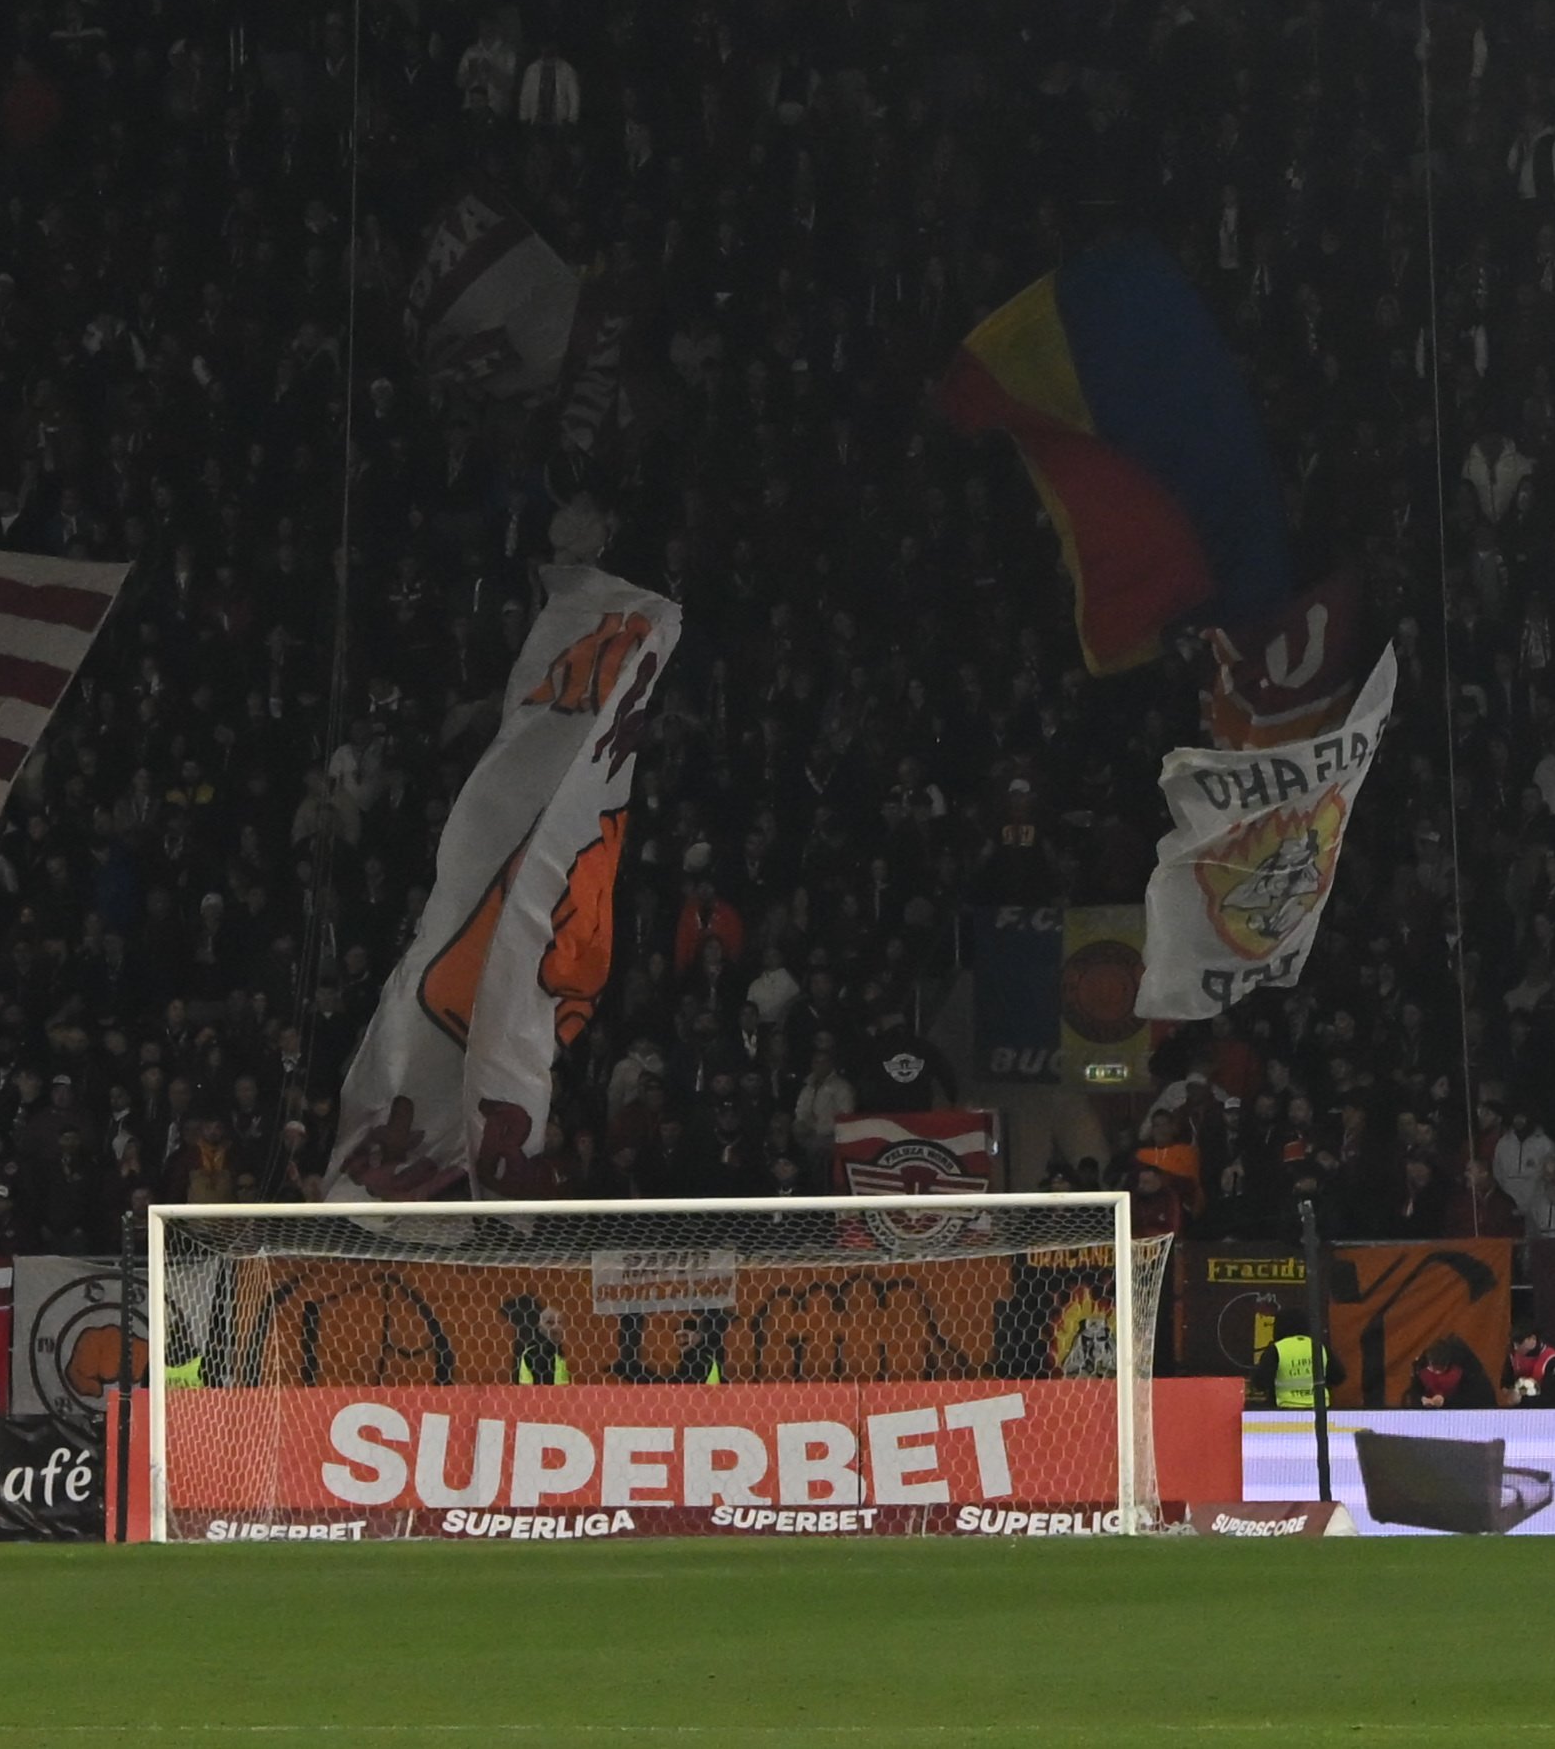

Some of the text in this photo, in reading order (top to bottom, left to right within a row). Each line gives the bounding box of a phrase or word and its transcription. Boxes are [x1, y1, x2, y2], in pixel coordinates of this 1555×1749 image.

[321, 1392, 1026, 1509] SUPERBET
[206, 1519, 368, 1542] SUPERBET
[441, 1508, 635, 1539] SUPERLIGA
[710, 1505, 877, 1532] SUPERBET
[1211, 1512, 1309, 1537] SUPERSCORE
